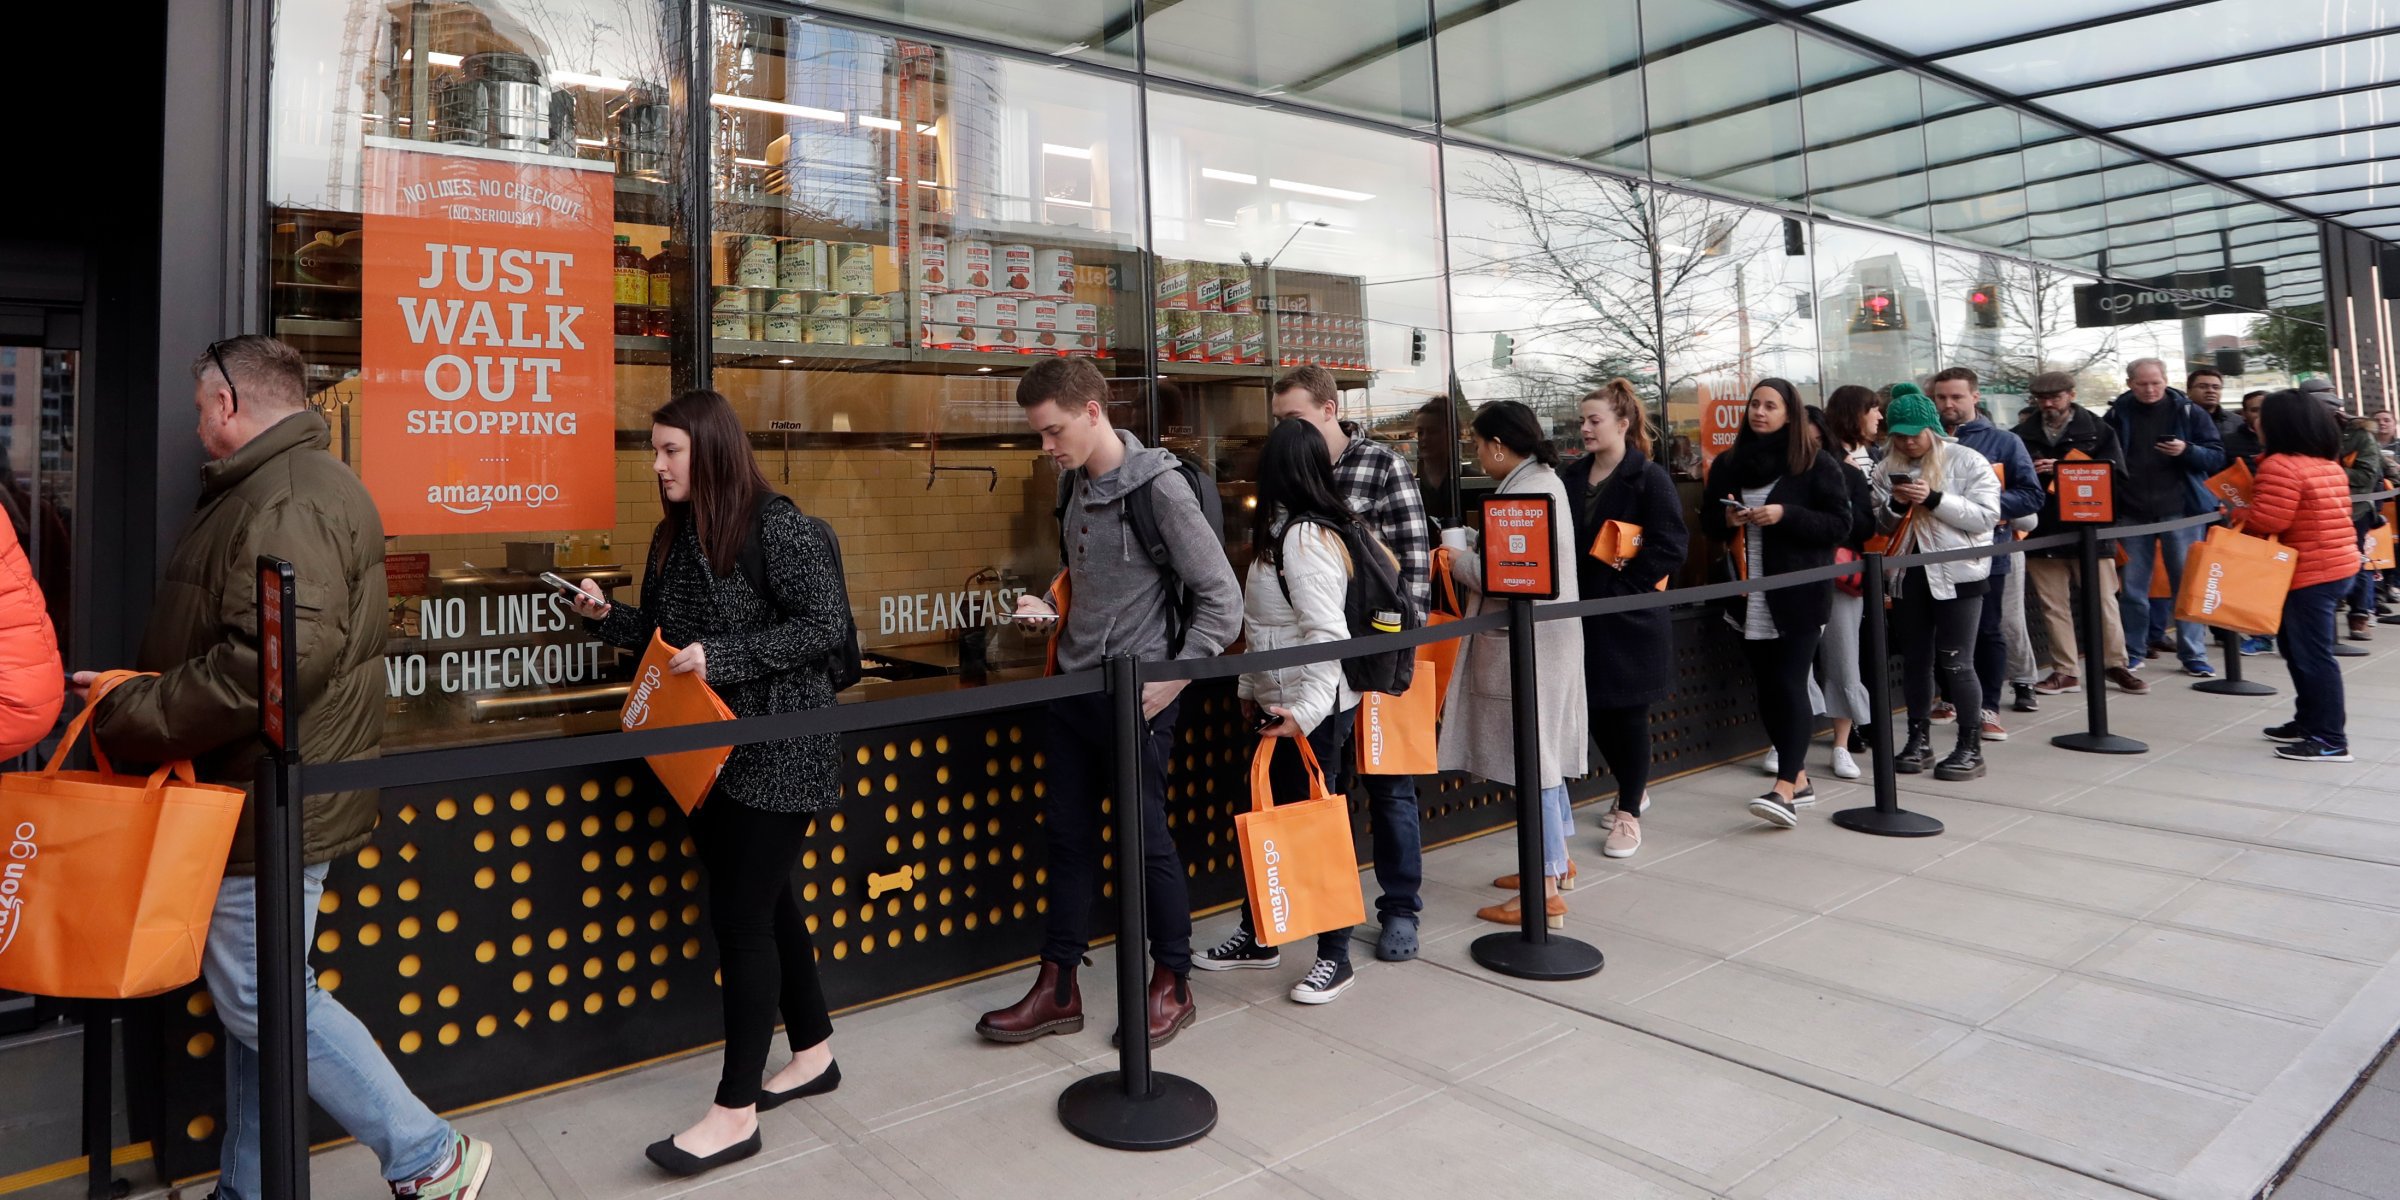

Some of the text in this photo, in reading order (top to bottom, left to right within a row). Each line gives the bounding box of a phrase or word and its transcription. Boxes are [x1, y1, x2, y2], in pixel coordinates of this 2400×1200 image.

[402, 182, 427, 204] NO
[479, 179, 501, 197] NO
[418, 242, 574, 296] JUST
[397, 296, 585, 350] WALK
[424, 354, 561, 403] OUT
[406, 410, 577, 435] SHOPPING
[771, 421, 801, 430] Halton
[427, 483, 559, 508] amazon go
[1489, 506, 1544, 518] Get the app
[1498, 519, 1535, 527] to enter
[1511, 541, 1523, 551] go
[2202, 562, 2224, 615] amazon go
[420, 592, 575, 641] NO LINES.
[384, 640, 607, 698] NO CHECKOUT.
[622, 665, 661, 730] amazon go
[1371, 707, 1380, 766] amazon
[9, 821, 38, 860] go
[1263, 839, 1287, 933] amazon go
